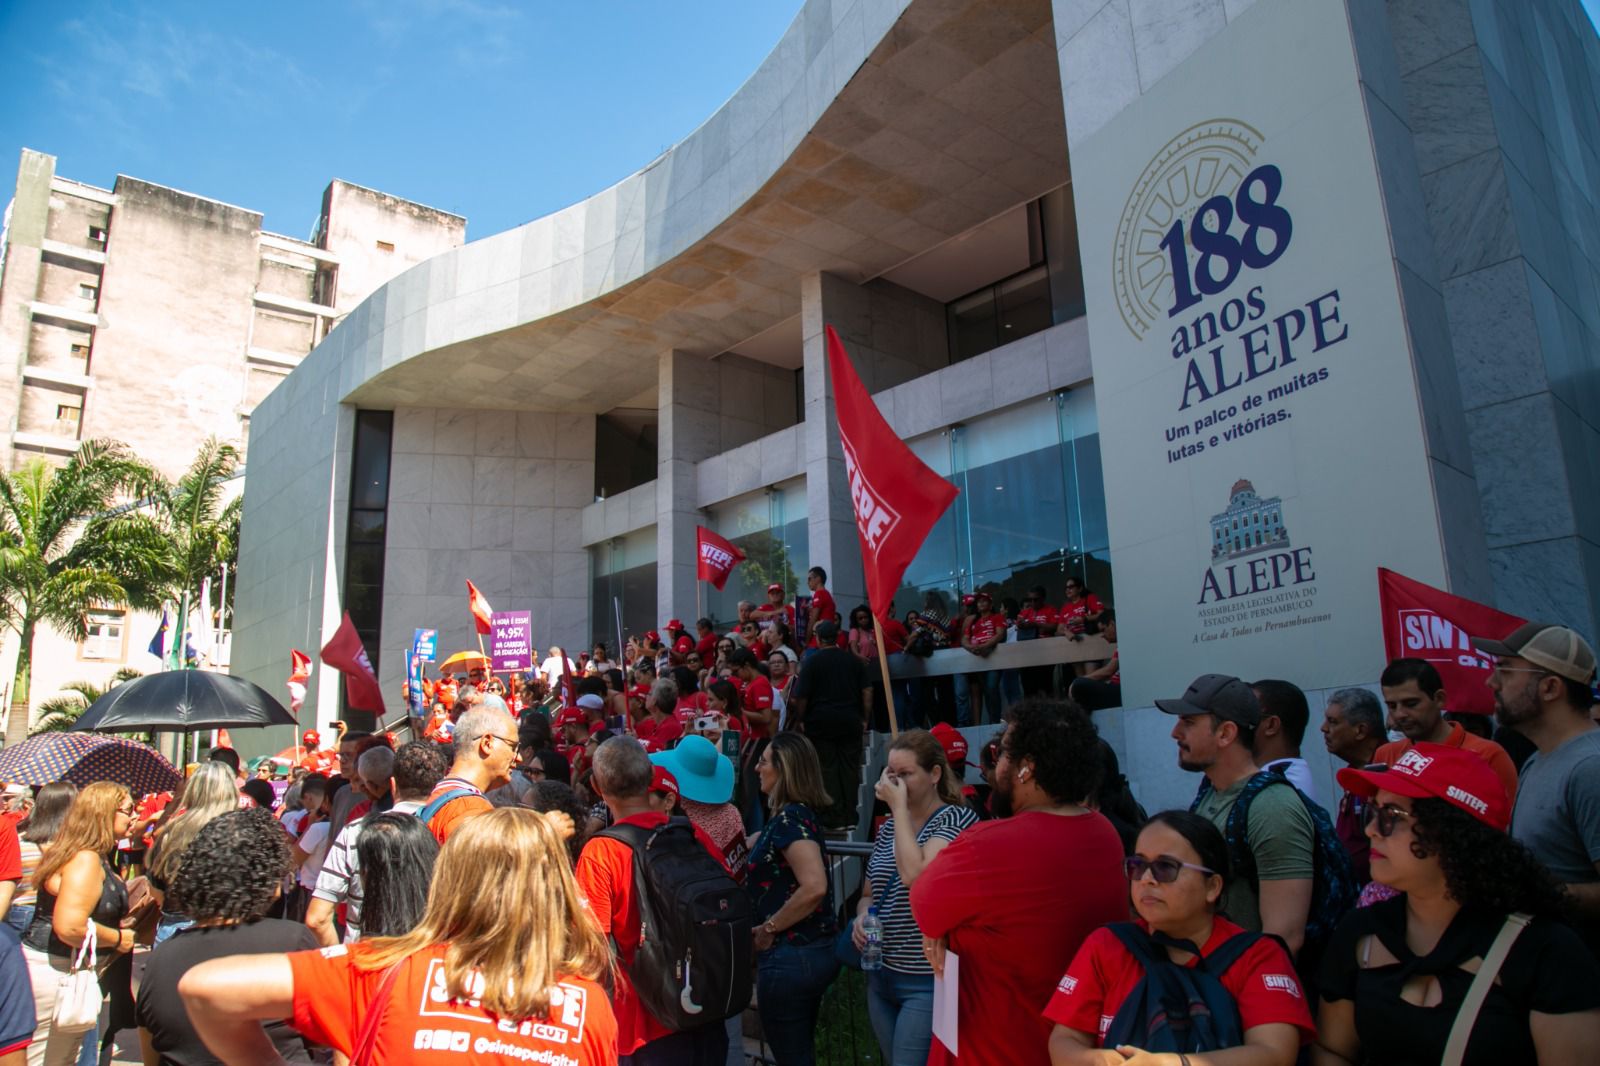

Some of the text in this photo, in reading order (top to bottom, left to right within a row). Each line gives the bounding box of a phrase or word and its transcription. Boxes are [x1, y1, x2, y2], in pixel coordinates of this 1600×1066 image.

[1159, 164, 1293, 318] 188
[1170, 285, 1266, 359] anos
[1178, 289, 1349, 411] ALEPE
[1165, 367, 1329, 442] Um palco de muitas
[1168, 408, 1292, 463] lutas e vitórias.
[1197, 547, 1315, 605] ALEPE
[1198, 587, 1317, 618] ASSEMBLEIA LEGISLATIVA DO
[1192, 634, 1200, 644] A
[1200, 632, 1218, 642] Casa
[1220, 629, 1229, 639] de
[1231, 626, 1252, 637] Todos
[1265, 613, 1332, 631] Pernambucanos
[1203, 599, 1313, 627] ESTADO DE PERNAMBUCO
[1446, 785, 1488, 815] SINTEPE
[535, 1025, 566, 1041] CUT
